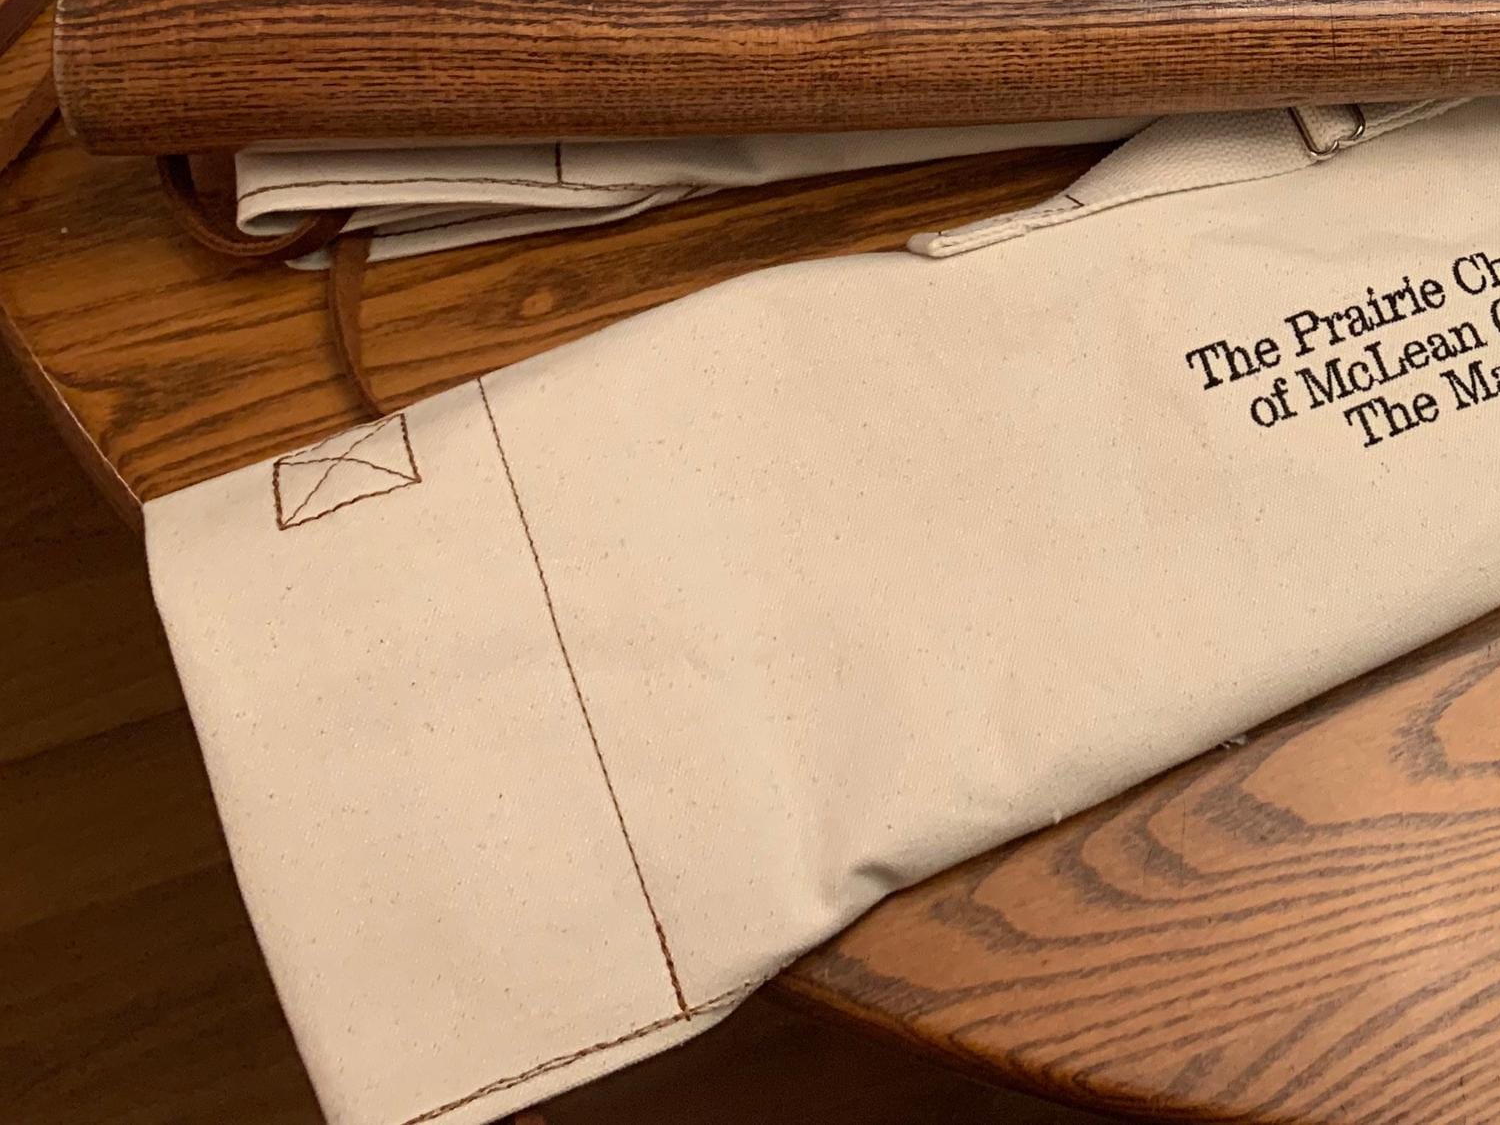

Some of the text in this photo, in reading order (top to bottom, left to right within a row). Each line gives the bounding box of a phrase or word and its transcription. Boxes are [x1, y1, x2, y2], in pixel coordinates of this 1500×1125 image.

[1184, 336, 1283, 392] The
[1282, 274, 1447, 359] Prairie
[1249, 376, 1299, 429] of
[1293, 320, 1490, 411] McLean
[1342, 391, 1441, 449] The
